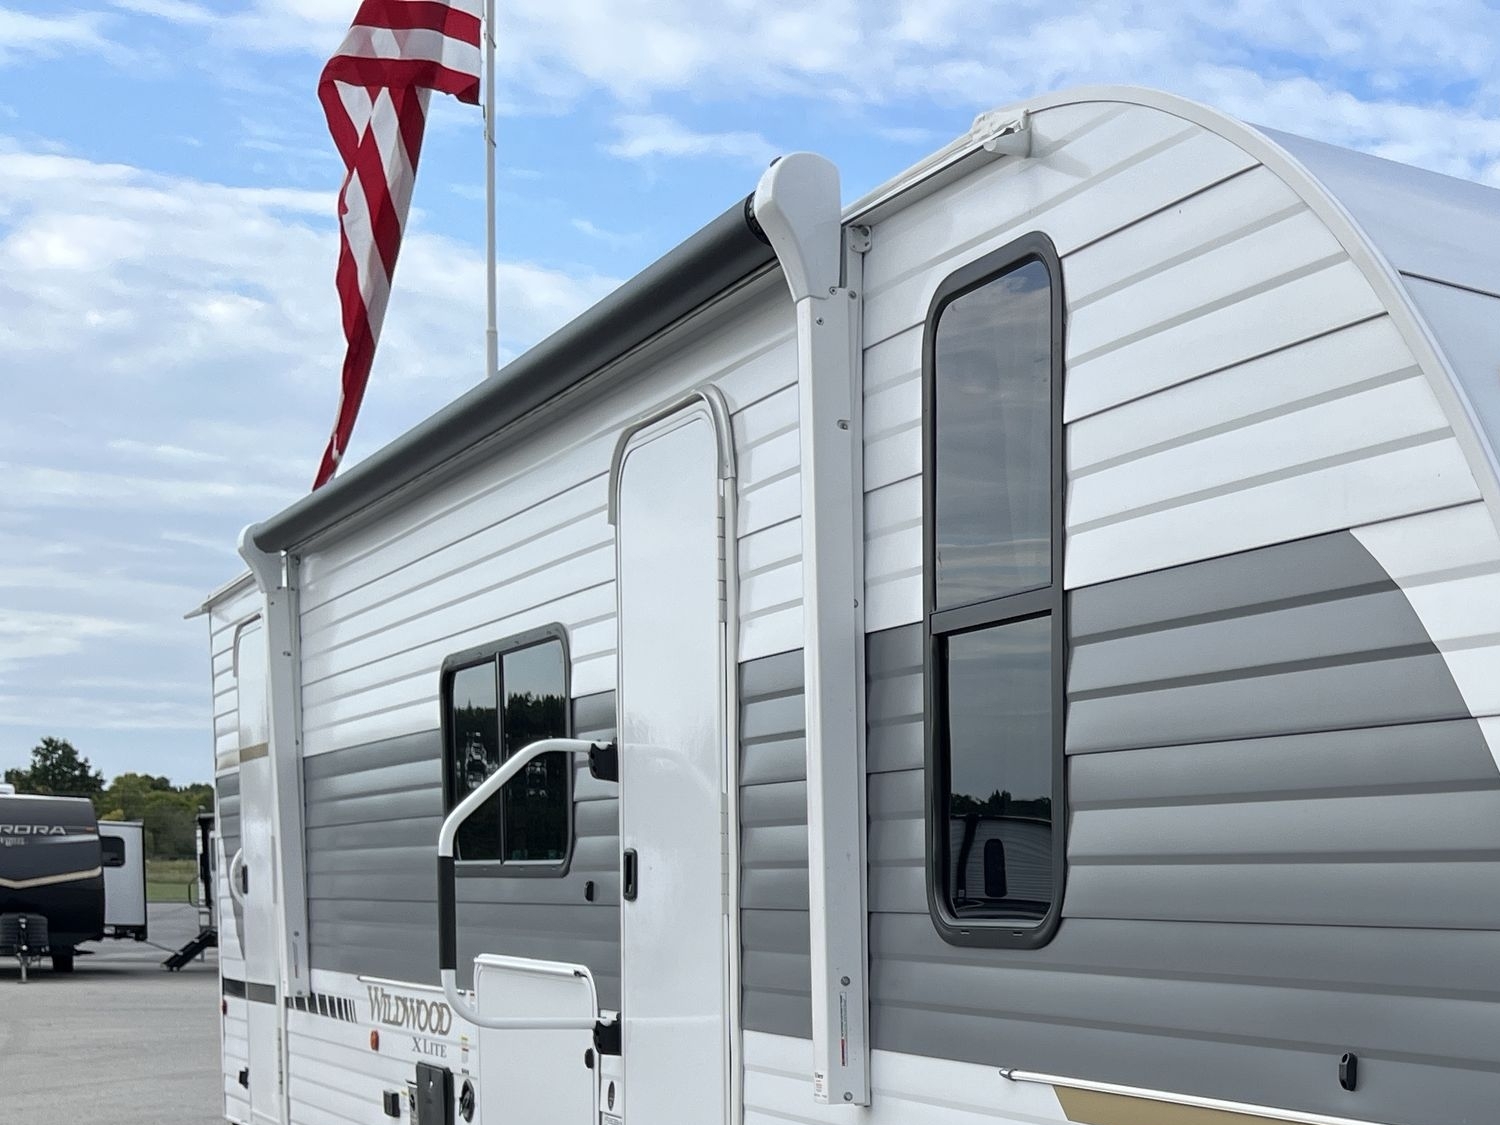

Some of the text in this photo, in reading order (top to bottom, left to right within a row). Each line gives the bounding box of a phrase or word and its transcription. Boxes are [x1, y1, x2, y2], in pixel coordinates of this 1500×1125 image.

[367, 985, 452, 1036] WILDWOOD
[412, 1036, 421, 1053] X
[423, 1038, 447, 1058] LITE
